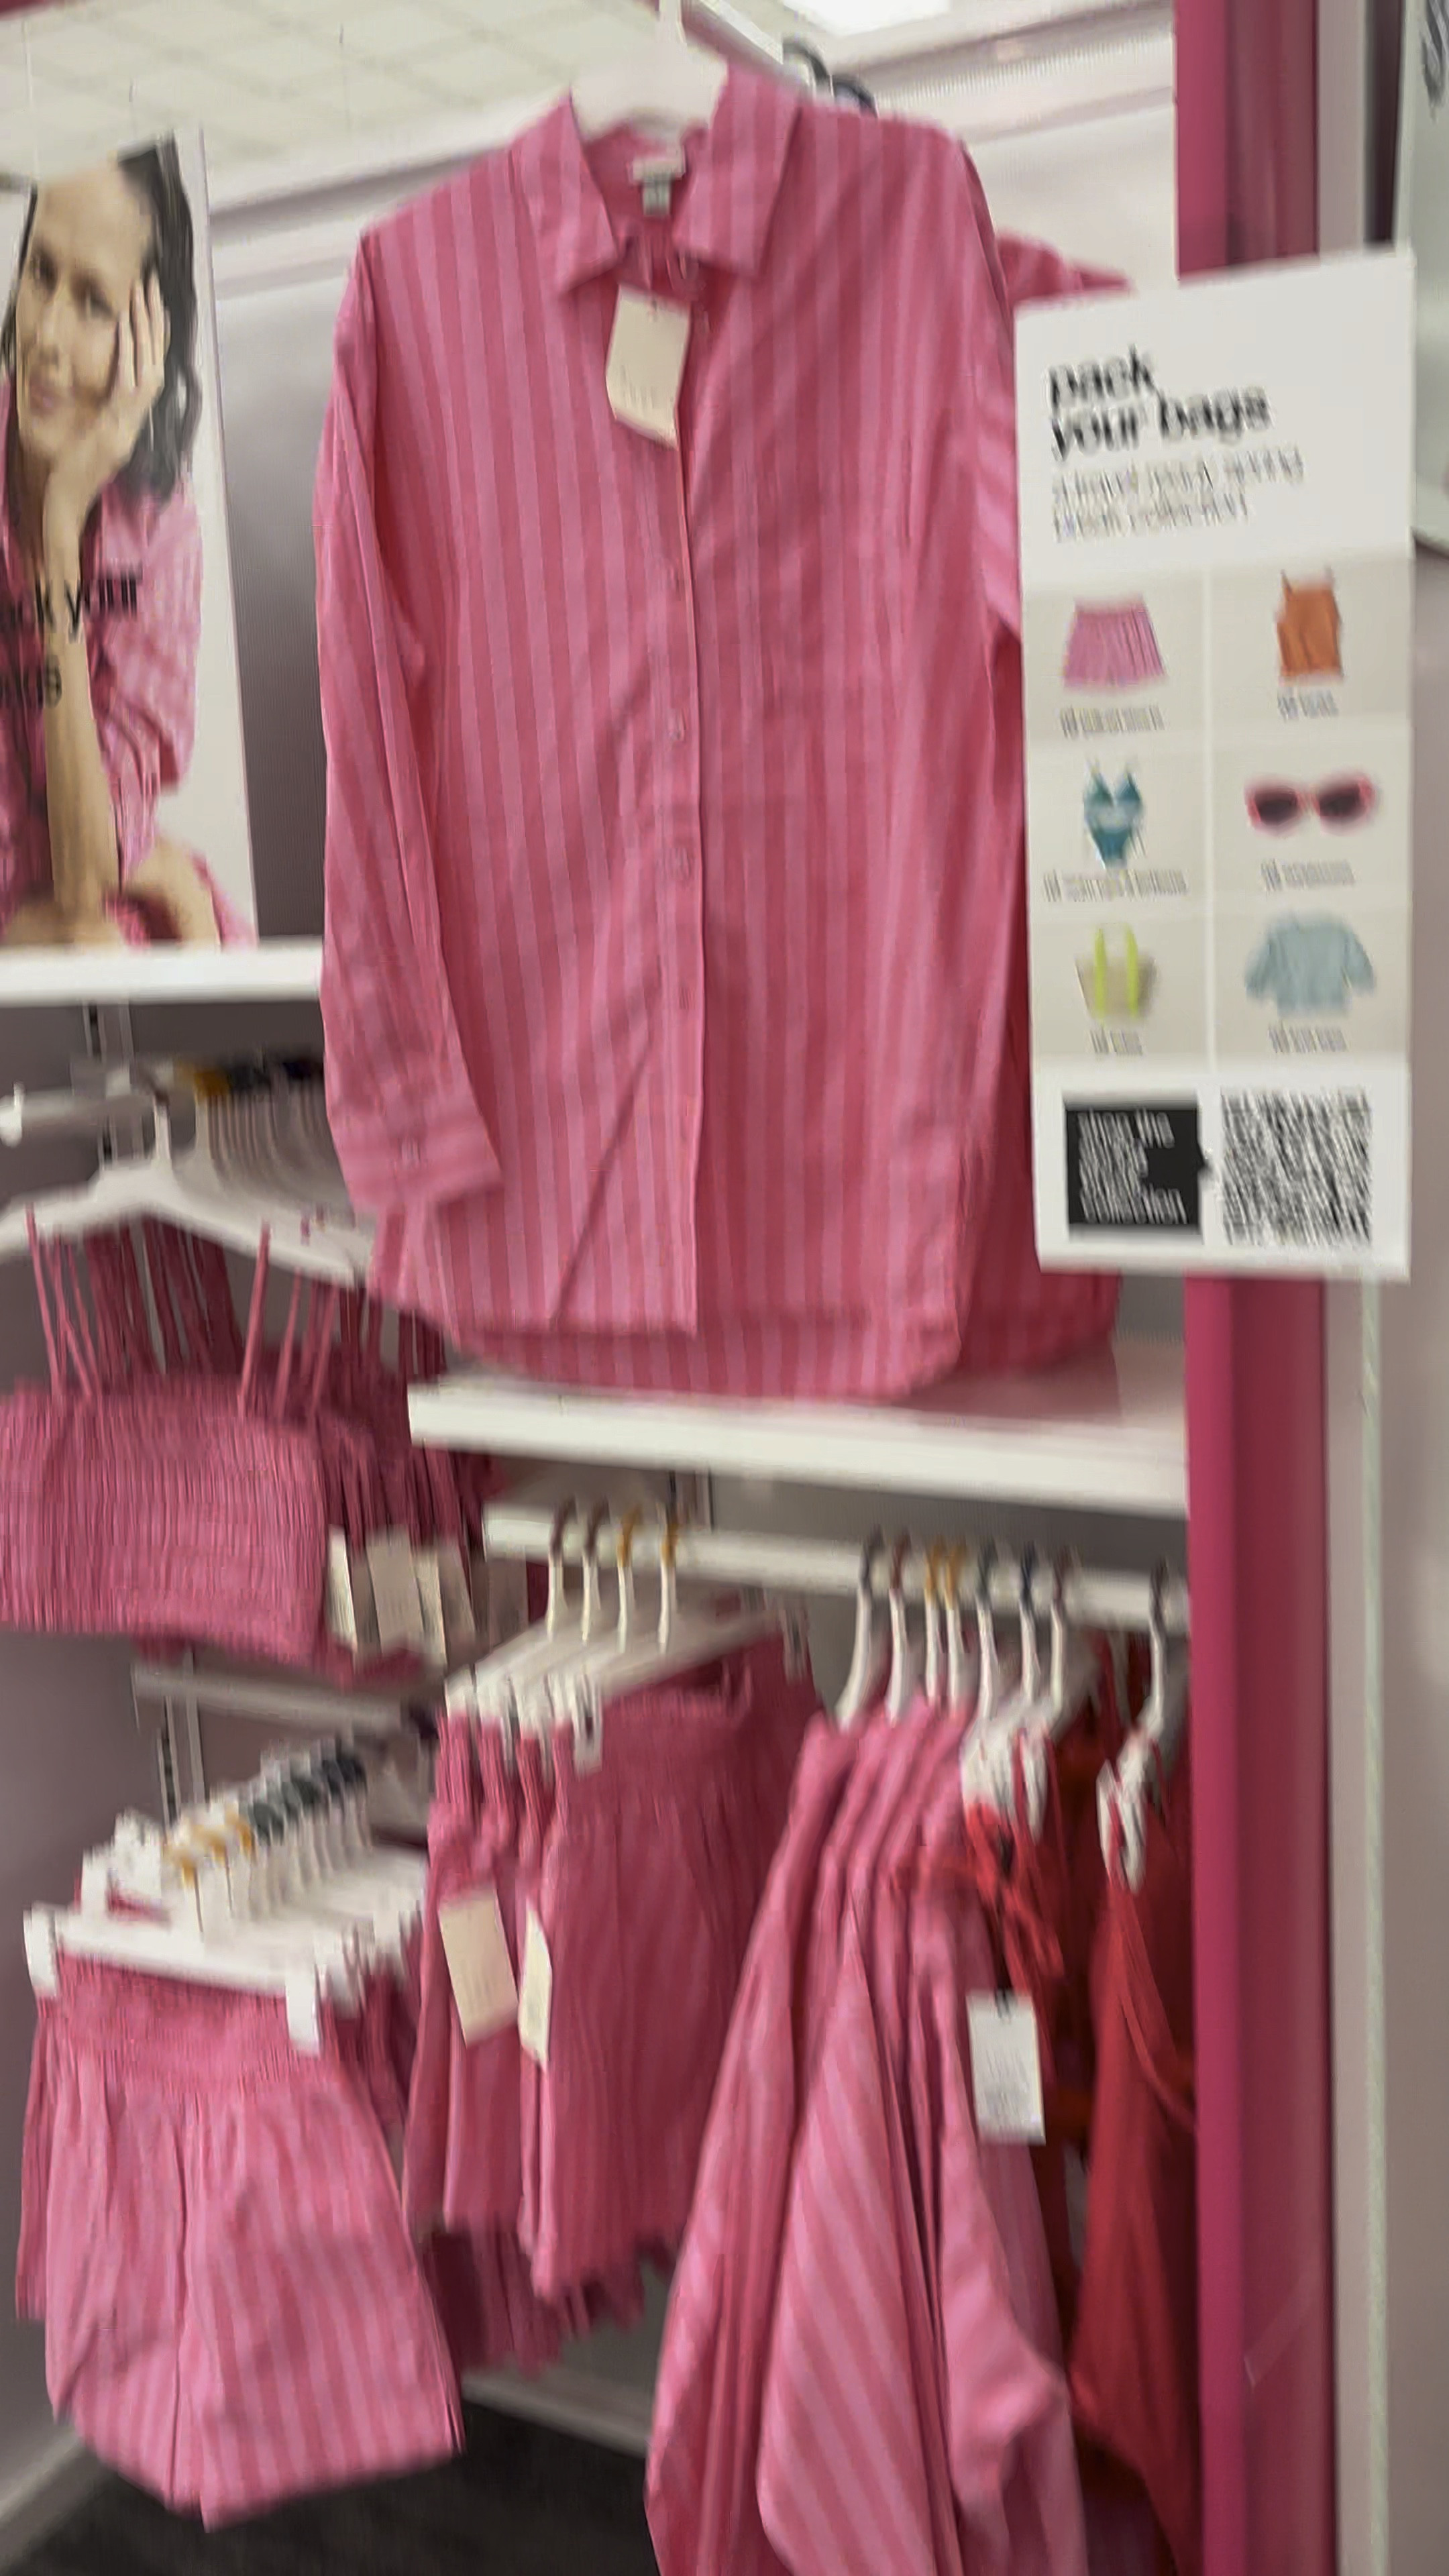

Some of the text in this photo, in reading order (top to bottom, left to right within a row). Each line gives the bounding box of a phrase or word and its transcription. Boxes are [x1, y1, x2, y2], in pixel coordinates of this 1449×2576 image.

[1048, 344, 1156, 413] pack
[1051, 385, 1272, 462] your bags
